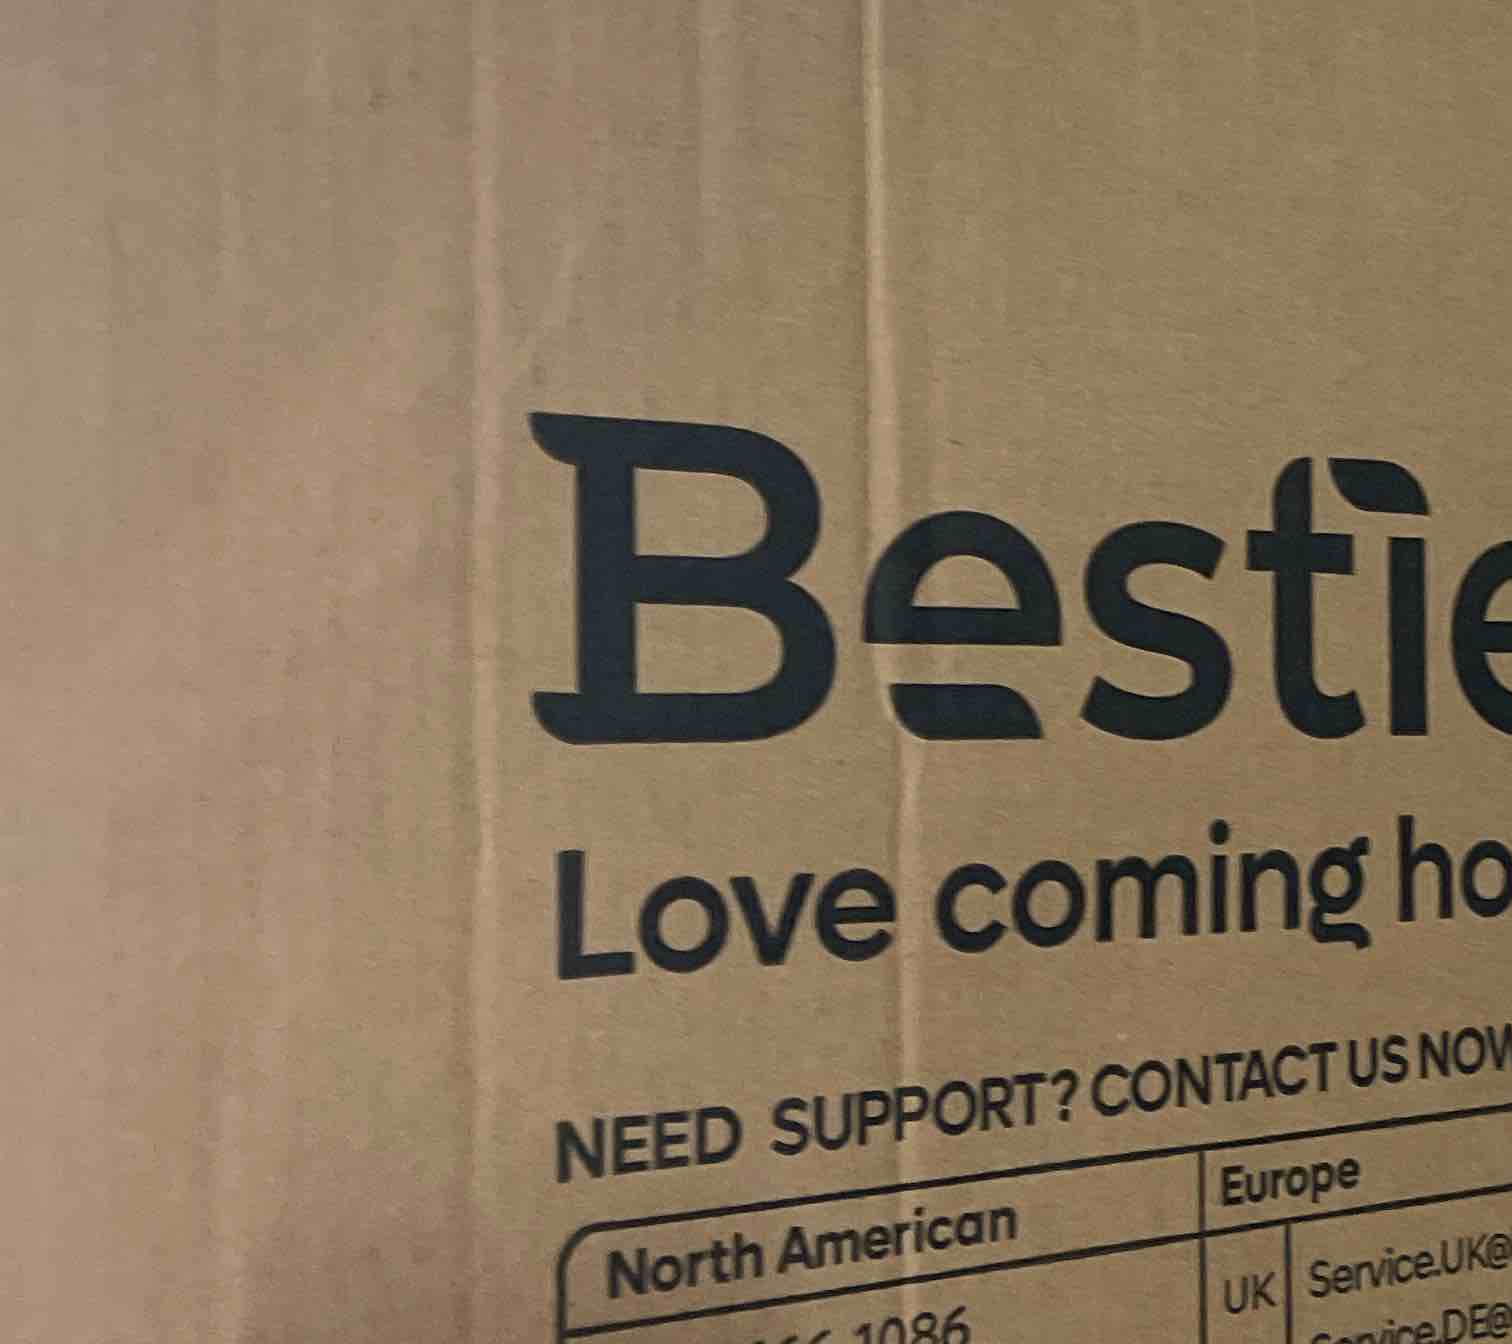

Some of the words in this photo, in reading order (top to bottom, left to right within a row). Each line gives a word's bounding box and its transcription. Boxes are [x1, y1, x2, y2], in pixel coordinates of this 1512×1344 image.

[556, 849, 896, 981] Love
[934, 818, 1372, 948] coming
[555, 1105, 742, 1183] NEED
[770, 1069, 1080, 1157] SUPPORT?
[1091, 1041, 1337, 1117] CONTACT
[1348, 1035, 1408, 1087] US
[1221, 1157, 1360, 1207] Europe
[607, 1232, 763, 1299] North
[777, 1207, 1018, 1273] American
[1224, 1272, 1277, 1315] UK
